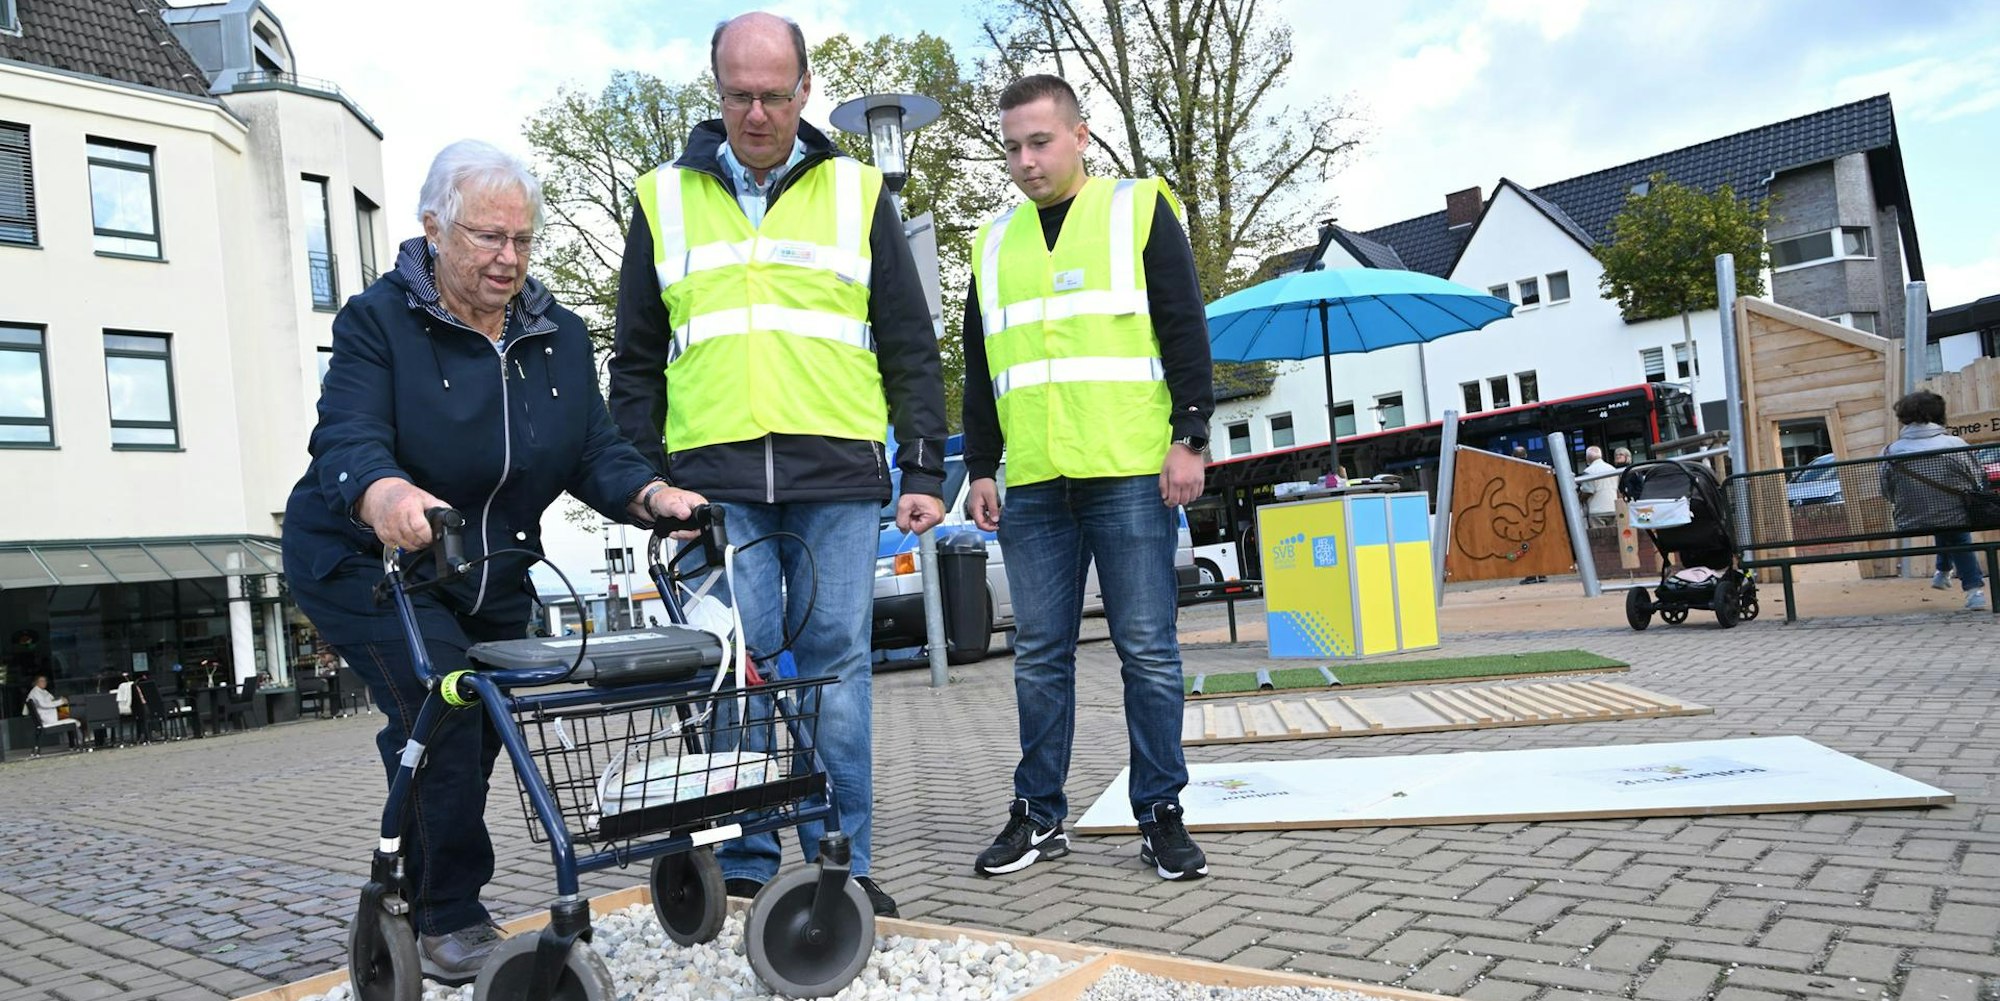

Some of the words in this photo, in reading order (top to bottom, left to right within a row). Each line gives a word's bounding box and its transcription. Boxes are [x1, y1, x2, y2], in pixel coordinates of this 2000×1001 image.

[1608, 401, 1630, 409] MAN
[1946, 422, 1981, 437] ante
[1272, 544, 1296, 560] SVB
